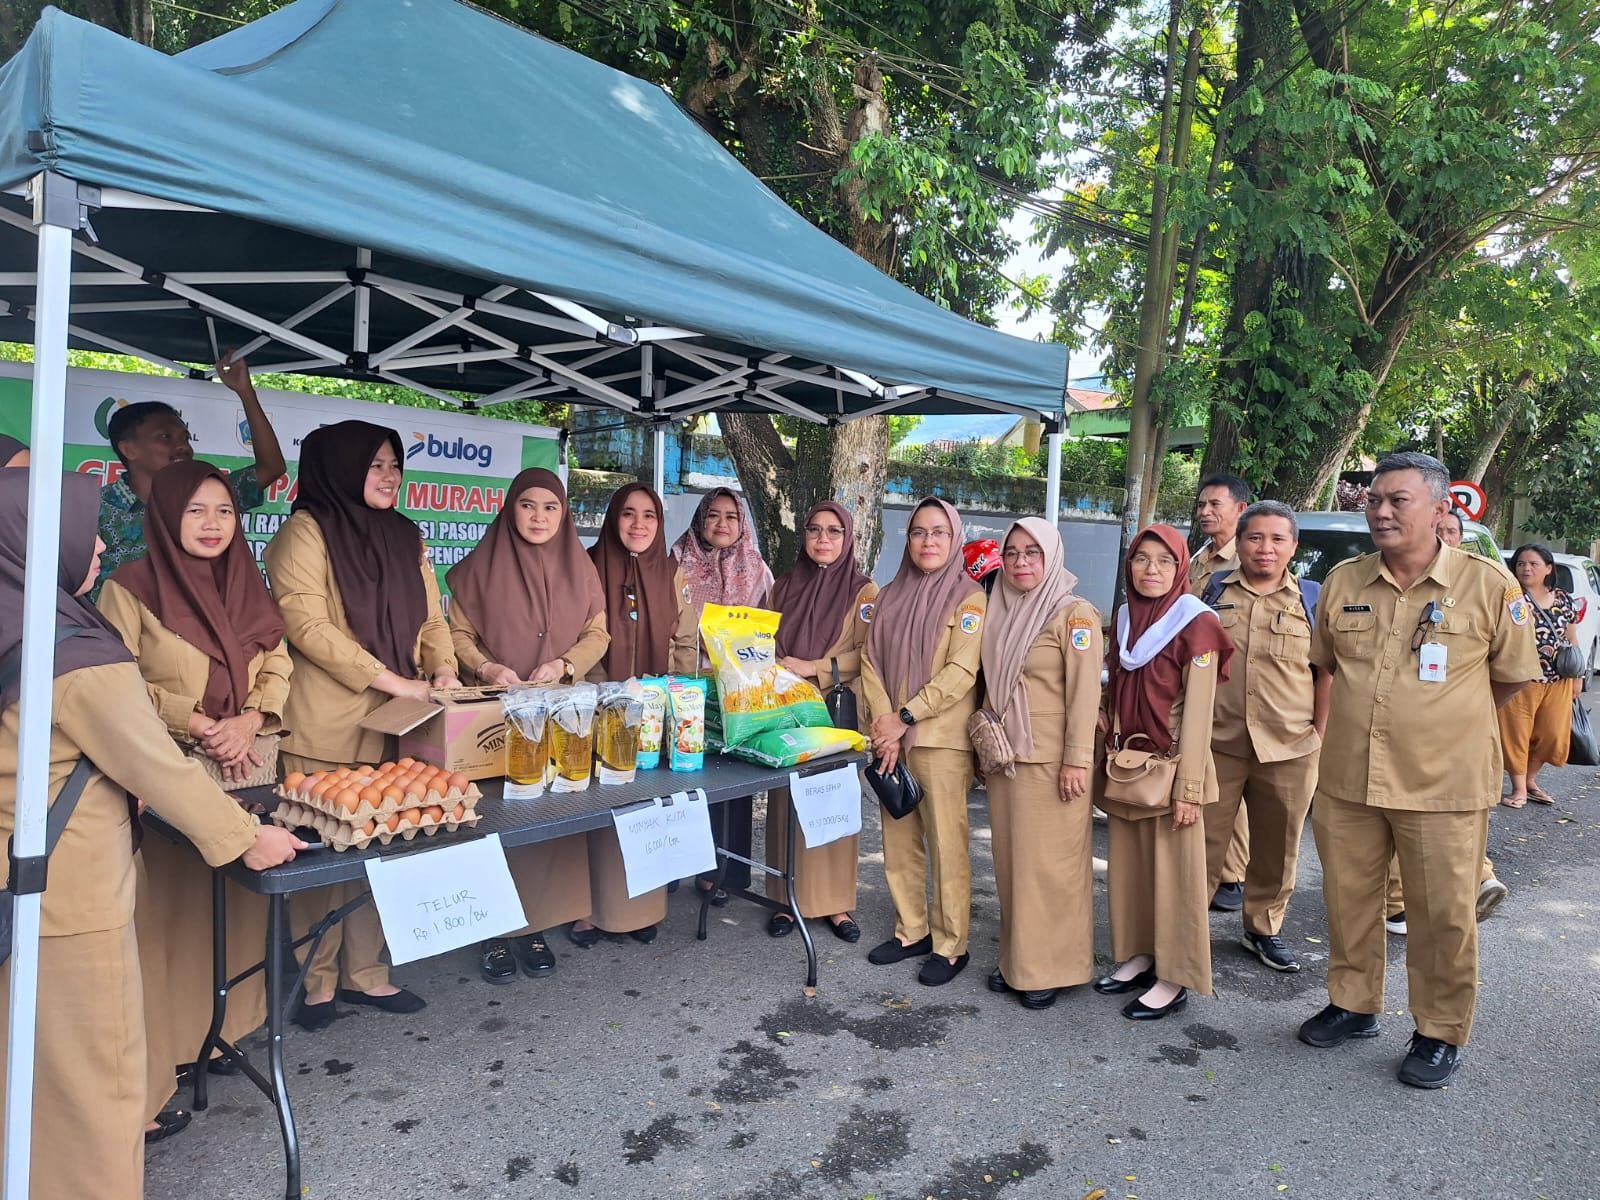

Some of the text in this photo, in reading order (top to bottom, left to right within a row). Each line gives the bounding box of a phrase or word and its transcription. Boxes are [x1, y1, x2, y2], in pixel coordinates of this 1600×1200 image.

[427, 433, 492, 468] bulog
[405, 481, 504, 514] MURAH
[416, 889, 478, 913] TELUR
